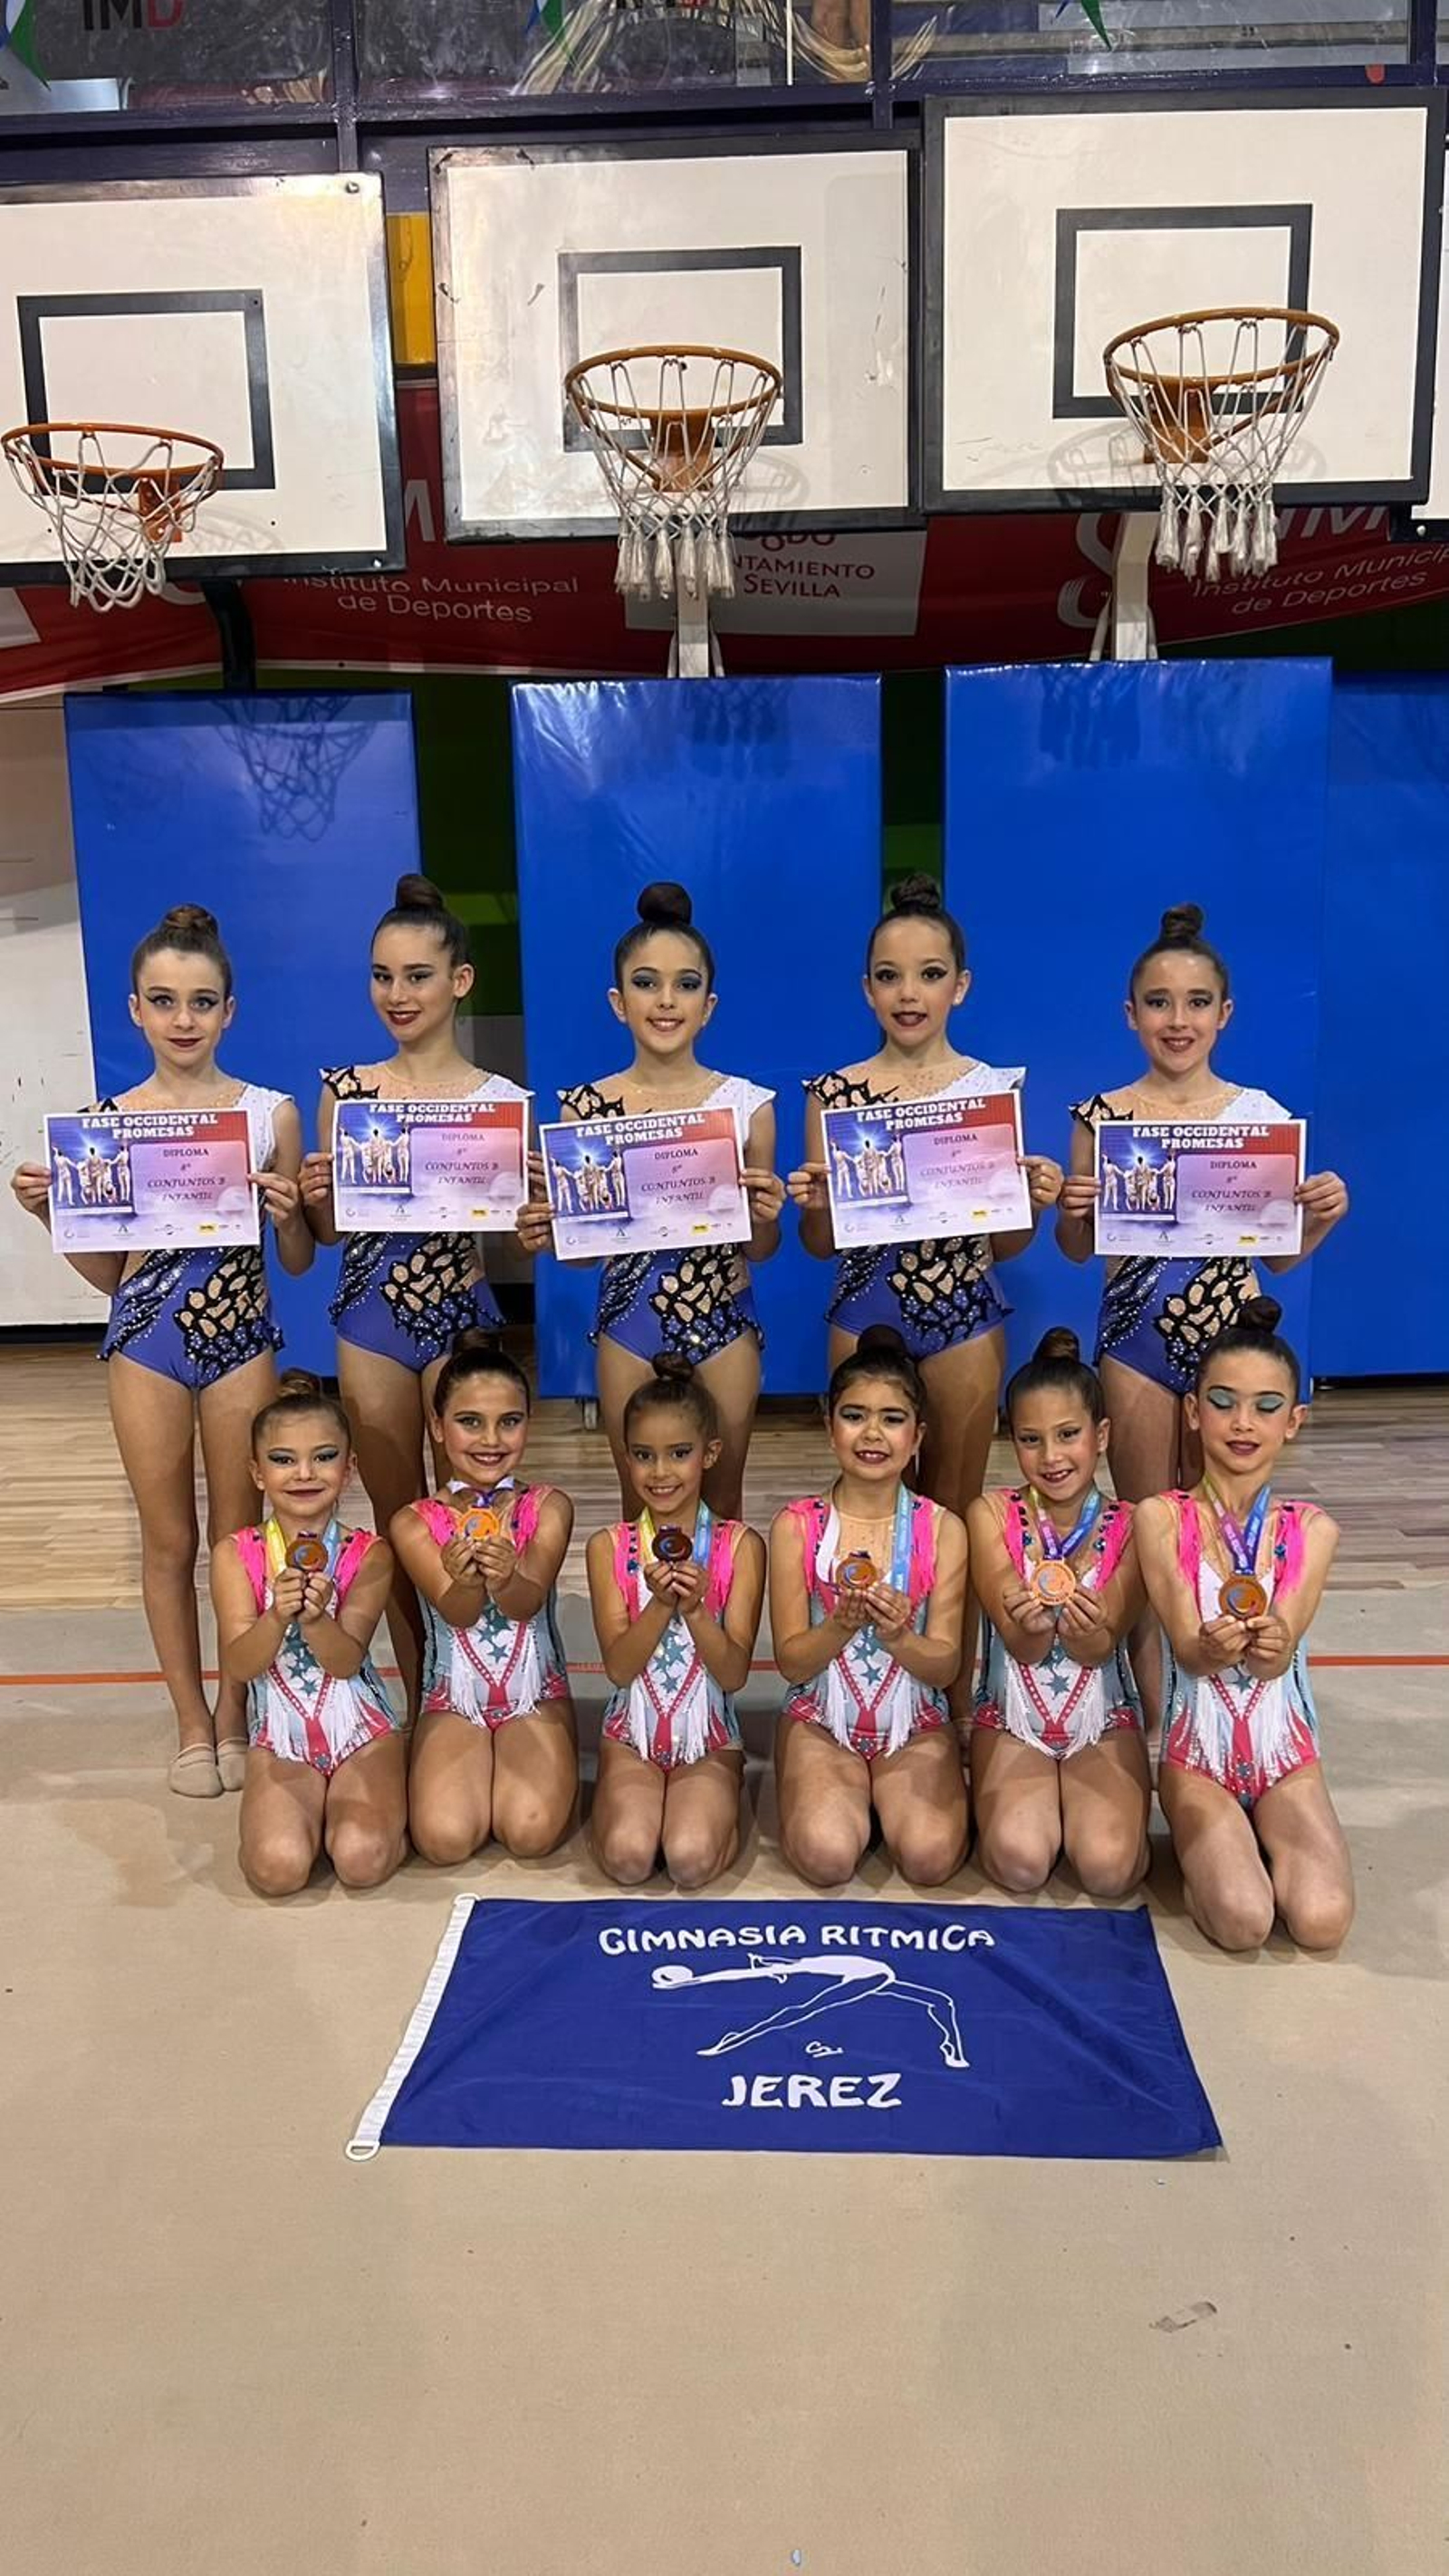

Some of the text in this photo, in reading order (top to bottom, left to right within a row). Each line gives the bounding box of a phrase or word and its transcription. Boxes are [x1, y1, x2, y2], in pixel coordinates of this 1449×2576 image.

[82, 0, 185, 31] IMD
[733, 554, 875, 580] NTAMIENTO
[1333, 544, 1449, 579] Municip
[422, 577, 579, 597] Municipal
[743, 573, 840, 599] SEVILLA
[1231, 570, 1427, 615] de Deportes
[337, 593, 533, 622] de Deportes
[369, 1103, 496, 1113] FASE OCCIDENTAL
[858, 1098, 985, 1122] FASE OCCIDENTAL
[82, 1114, 218, 1129] FASE OCCIDENTAL
[397, 1113, 473, 1123] PROMESAS
[576, 1113, 705, 1137] FASE OCCIDENTAL
[886, 1112, 963, 1130] PROMESAS
[112, 1127, 195, 1139] PROMESAS
[606, 1127, 683, 1146] PROMESAS
[934, 1134, 978, 1145] DIPLOMA
[1133, 1125, 1270, 1137] FASE OCCIDENTAL
[1162, 1138, 1244, 1149] PROMESAS
[163, 1149, 209, 1158] DIPLOMA
[655, 1149, 698, 1159] DIPLOMA
[1210, 1160, 1257, 1169] DIPLOMA
[1192, 1190, 1260, 1198] CONJUNTOS
[598, 1924, 996, 1956] GIMNASIA RITMICA
[721, 2072, 903, 2109] JEREZ
